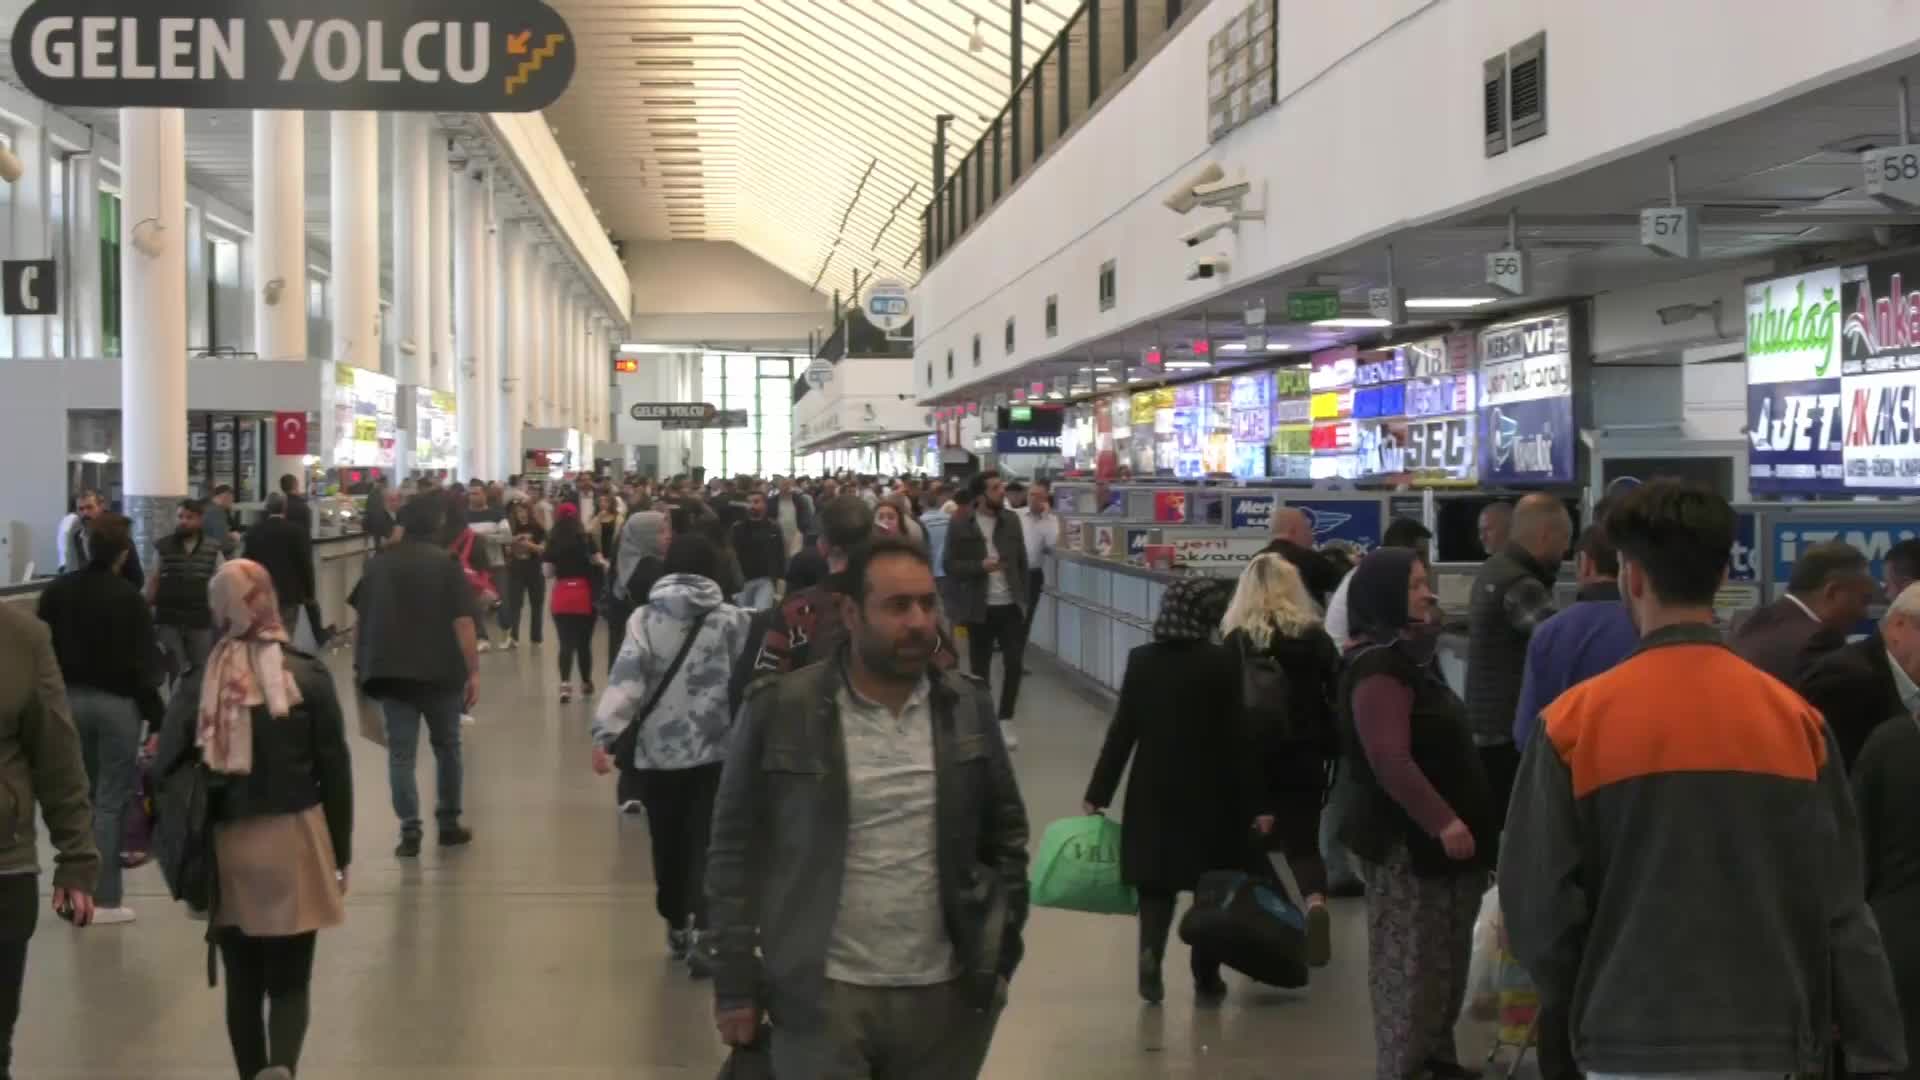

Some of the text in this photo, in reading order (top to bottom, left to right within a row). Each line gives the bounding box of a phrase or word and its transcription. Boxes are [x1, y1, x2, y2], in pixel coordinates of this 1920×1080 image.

[29, 16, 491, 84] GELEN YOLCU
[1883, 153, 1920, 182] 58
[1654, 214, 1683, 236] 57
[1495, 257, 1519, 276] 56
[633, 405, 704, 417] GELEN YOLCU
